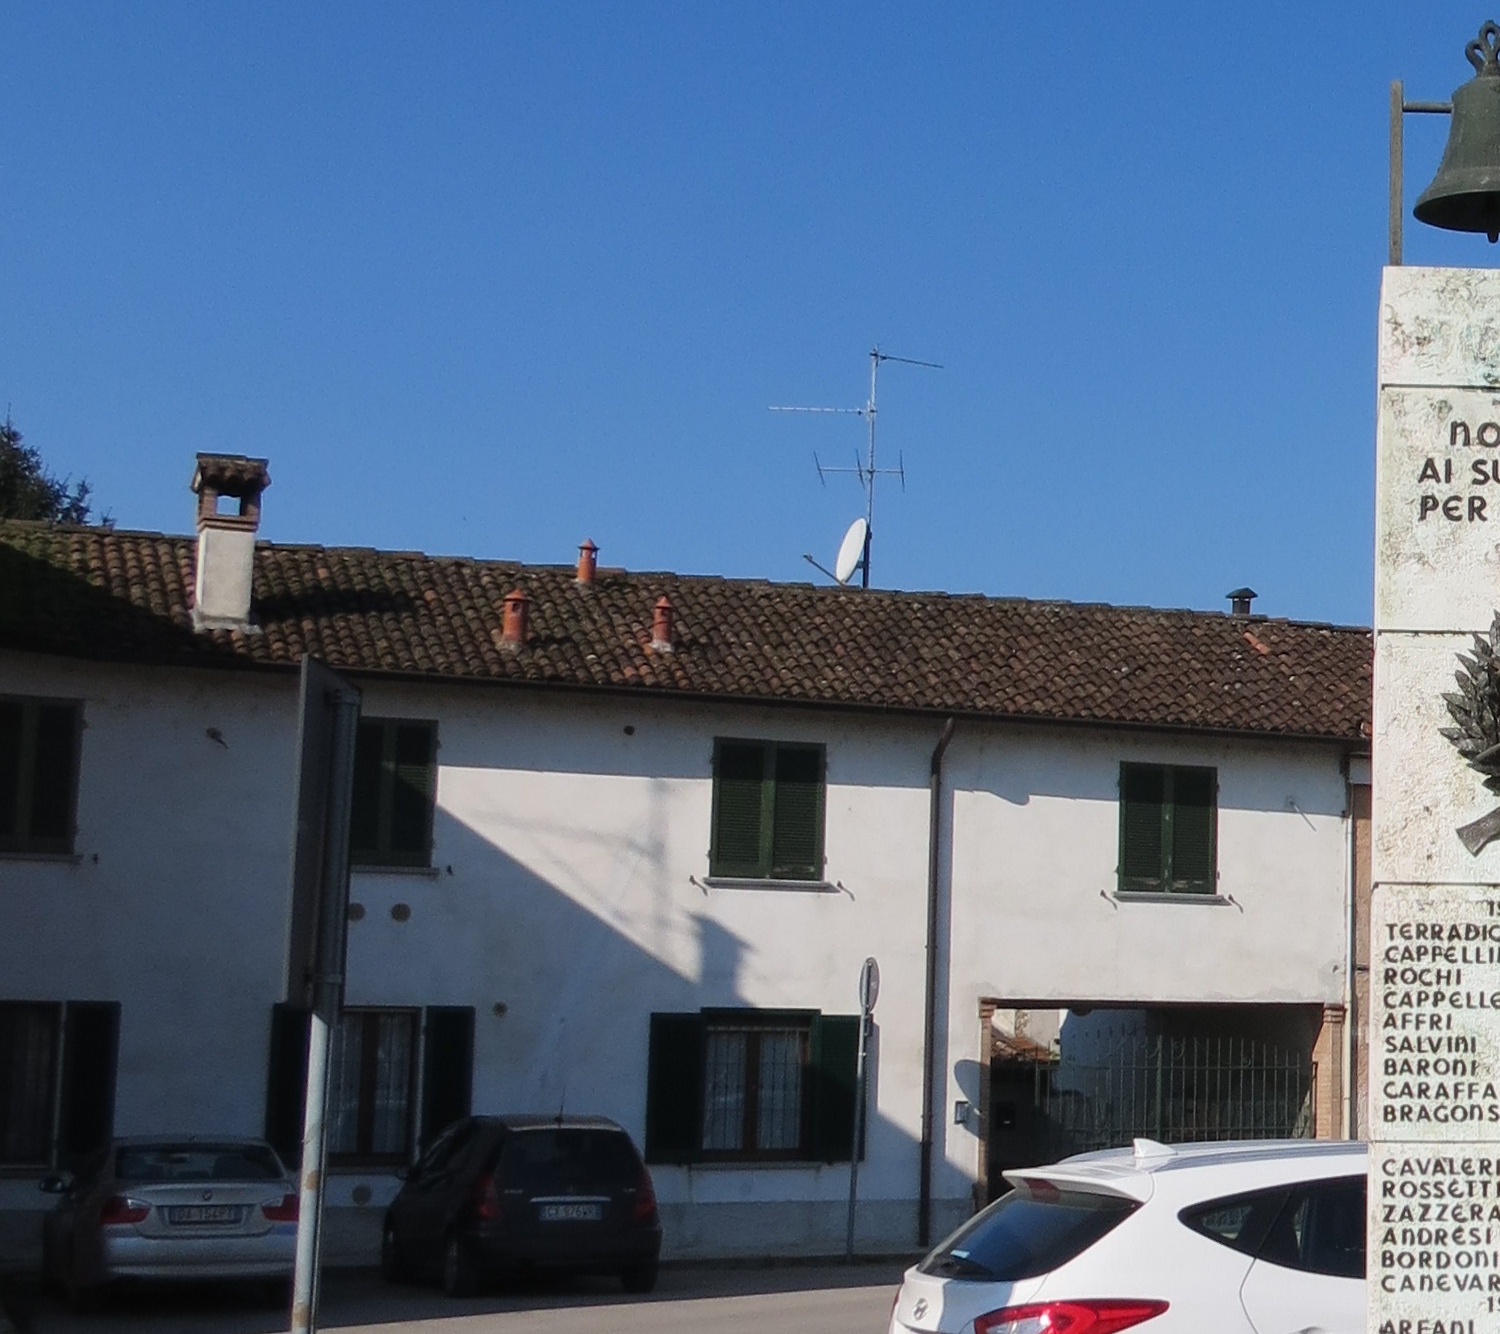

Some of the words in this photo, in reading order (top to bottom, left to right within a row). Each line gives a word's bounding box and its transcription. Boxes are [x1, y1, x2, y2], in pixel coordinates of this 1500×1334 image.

[1417, 457, 1453, 484] AI
[1418, 494, 1488, 523] PER
[1383, 967, 1461, 987] ROCHI
[1383, 1012, 1452, 1031] AFFRI
[1385, 1035, 1476, 1054] SALVINI
[1384, 1058, 1478, 1077] BARONI
[1383, 1081, 1497, 1100] CARAFFA
[1382, 1158, 1500, 1177] CAVALERI
[1382, 1226, 1491, 1246] ANDRESI
[1381, 1250, 1498, 1269] BORDONI
